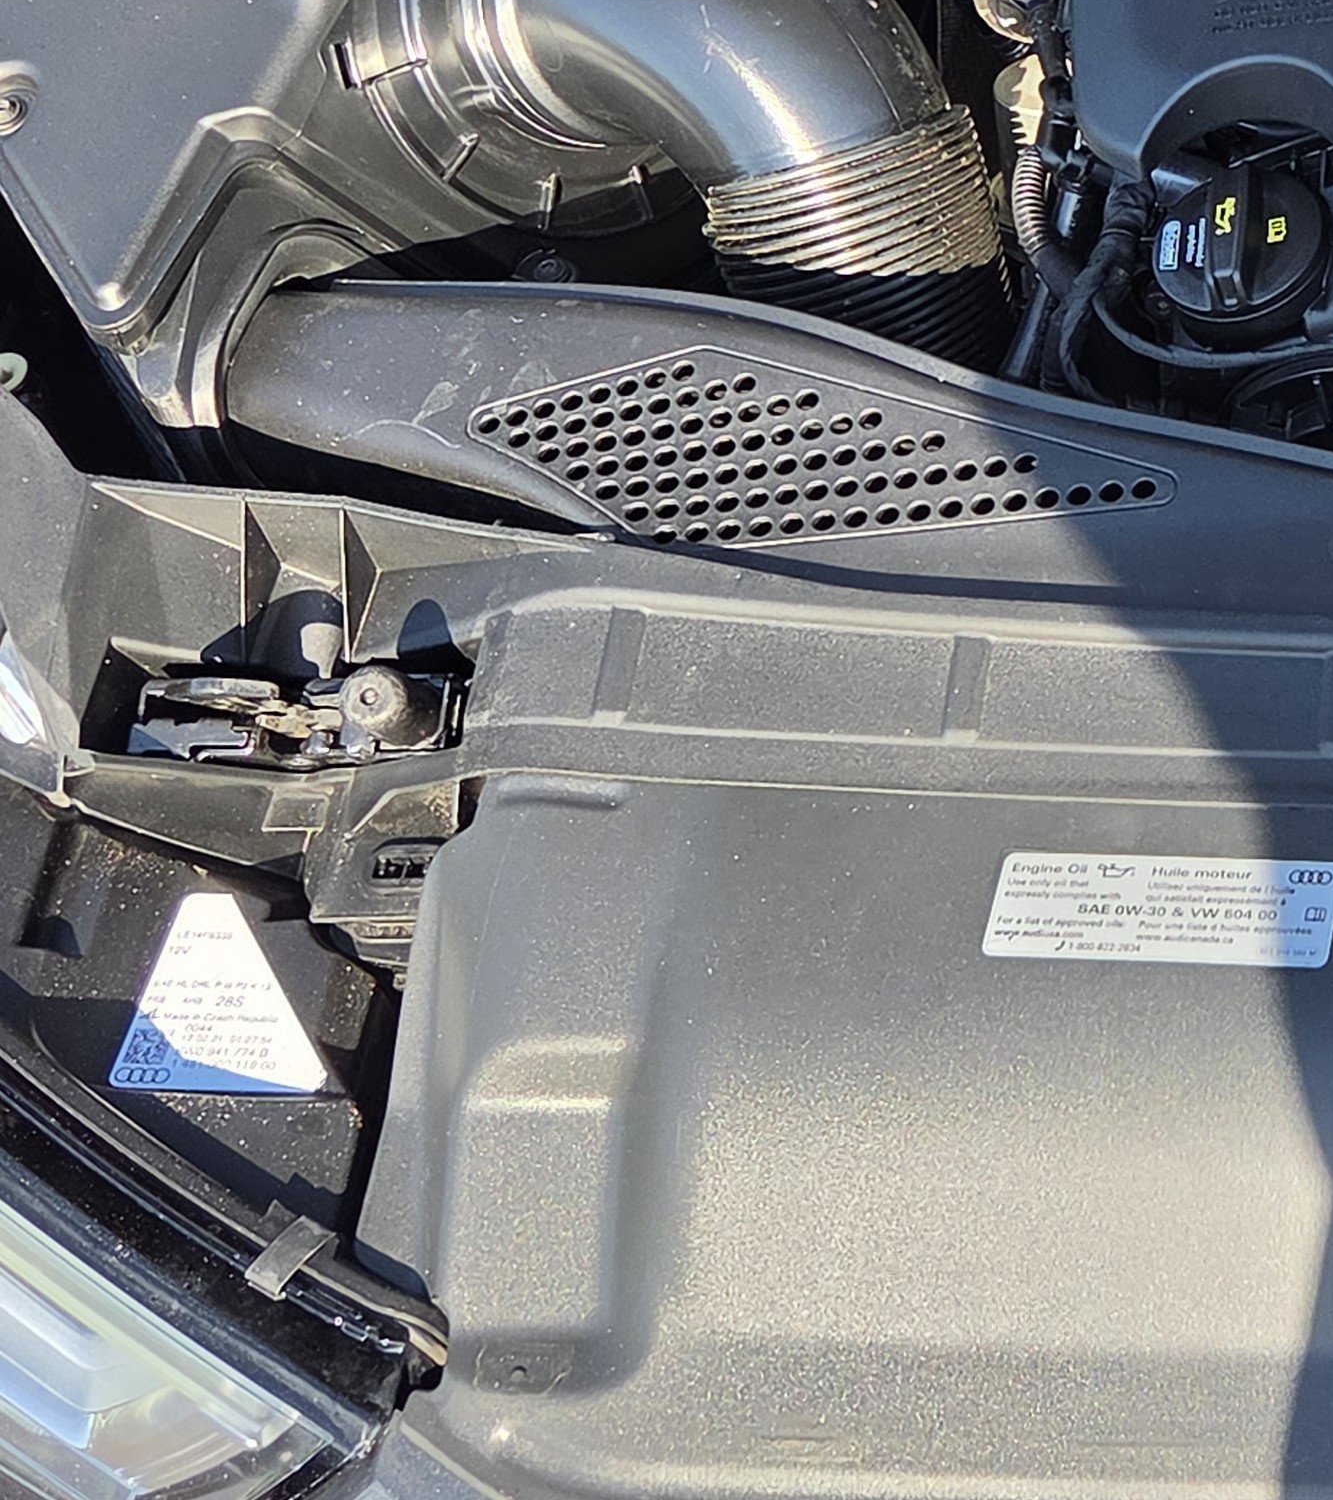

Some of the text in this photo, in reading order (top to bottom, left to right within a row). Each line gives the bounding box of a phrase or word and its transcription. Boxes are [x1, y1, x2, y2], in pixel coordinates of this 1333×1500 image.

[1012, 862, 1252, 880] Engine Oil Huile moteur
[1077, 903, 1111, 915] SAE
[1171, 907, 1184, 917] &
[1190, 907, 1220, 918] VW
